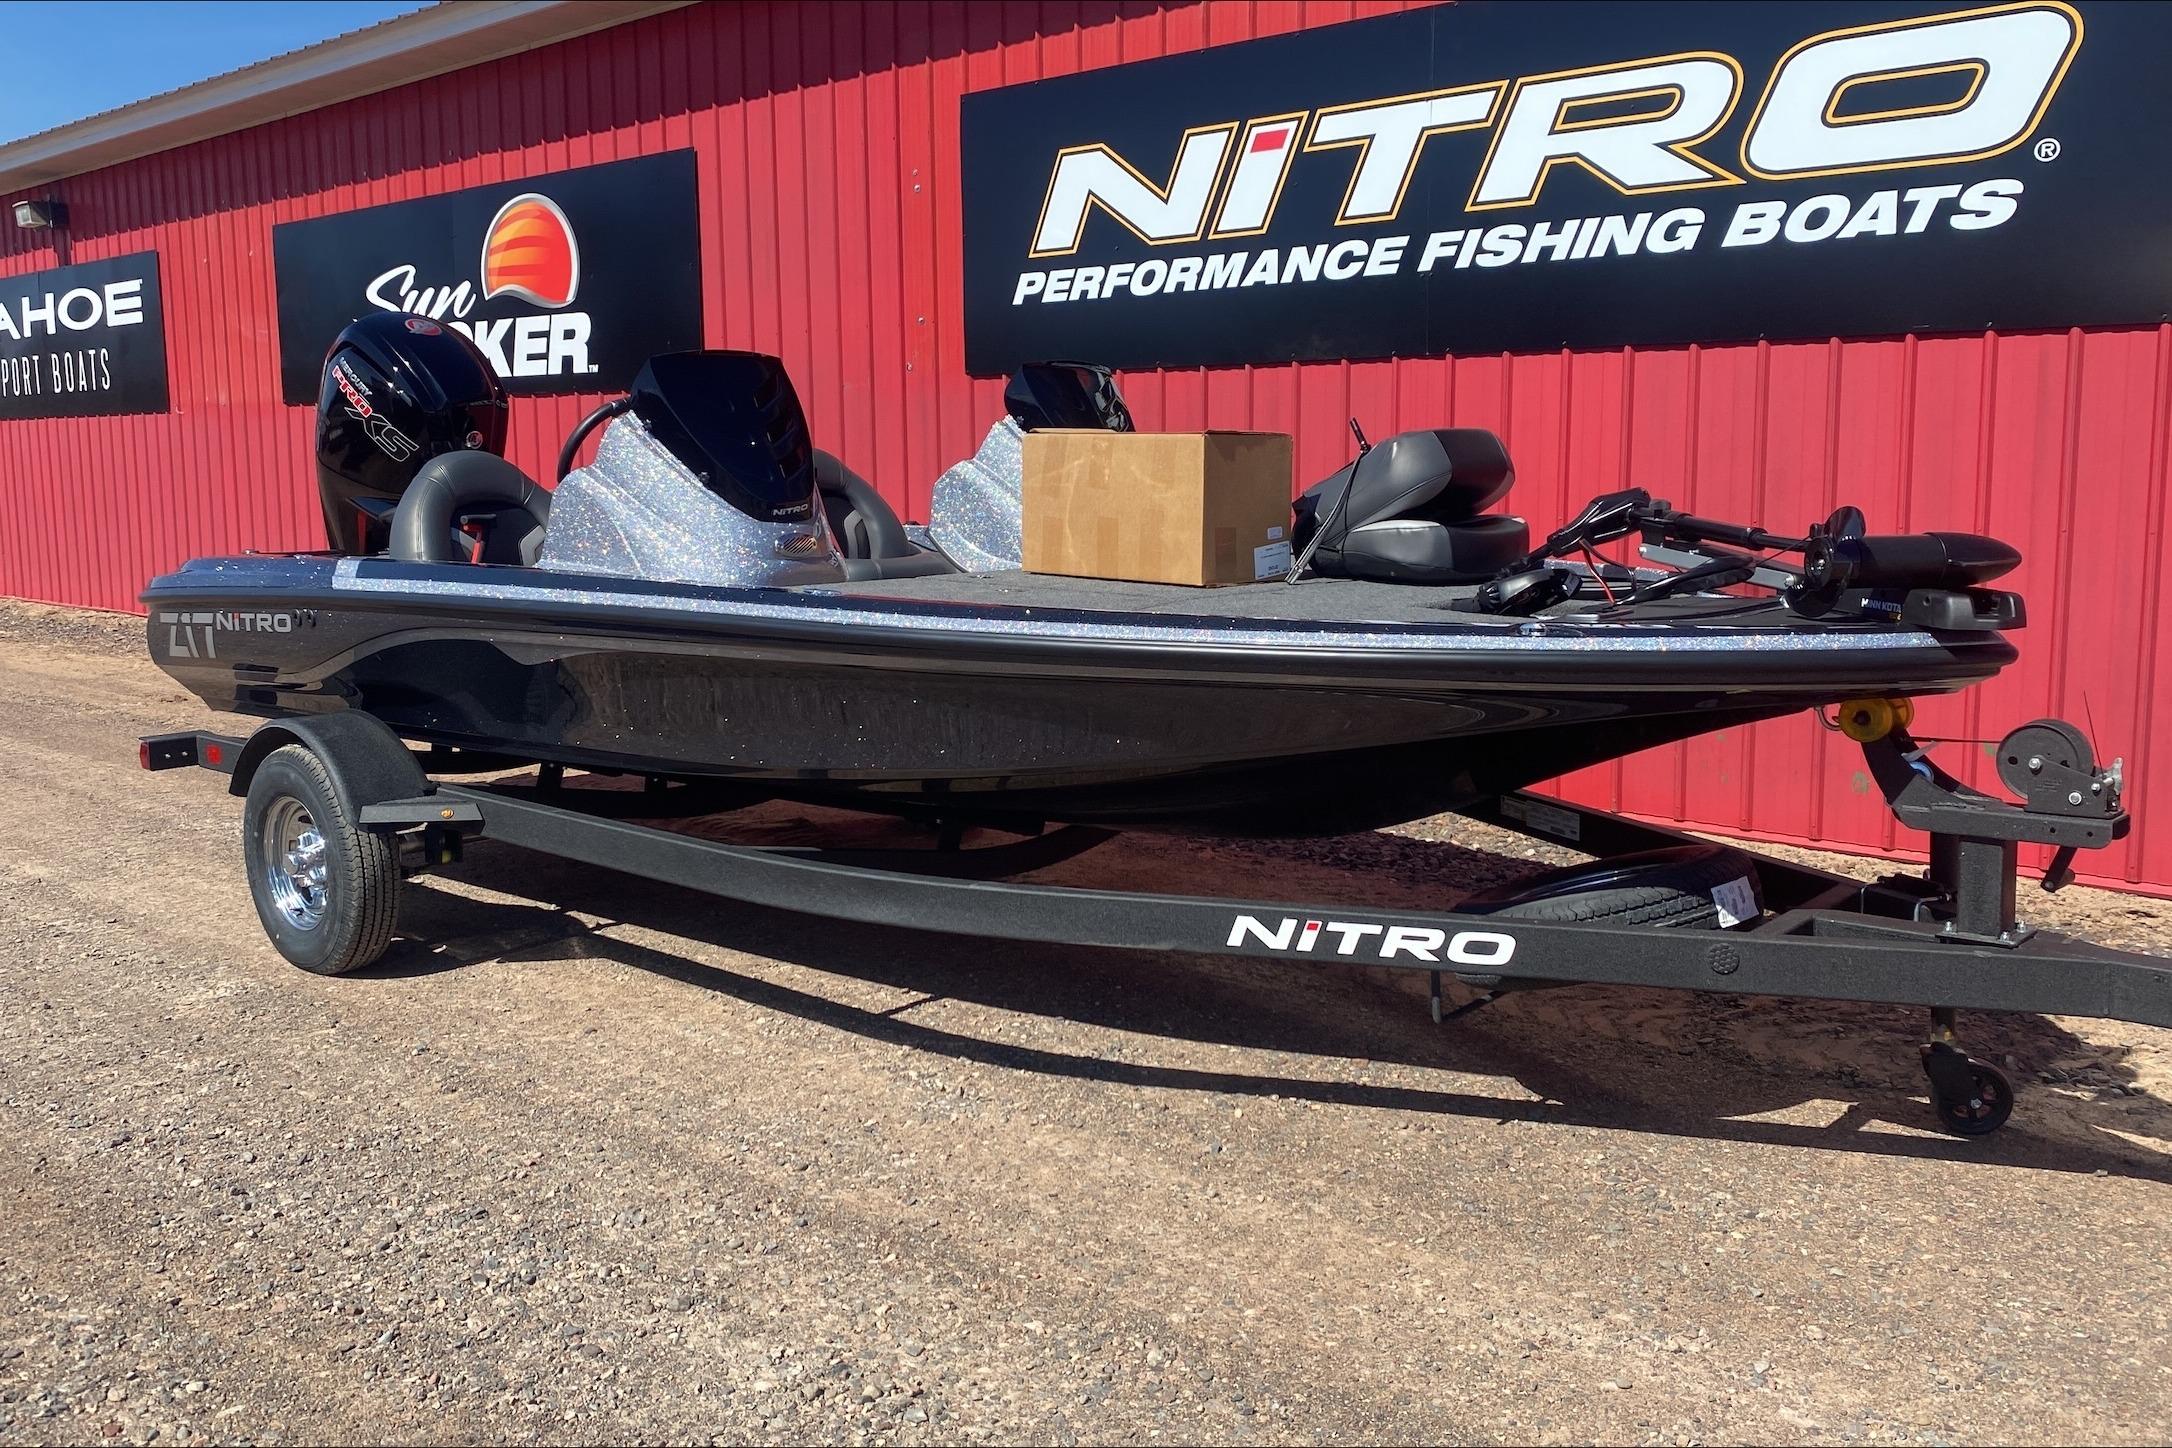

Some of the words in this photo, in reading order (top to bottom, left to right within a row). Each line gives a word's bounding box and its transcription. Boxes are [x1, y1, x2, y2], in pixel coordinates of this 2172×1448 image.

[1012, 236, 1402, 305] PERFORMANCE
[1417, 207, 1706, 274] FISHING
[1721, 178, 2025, 248] BOATS
[366, 264, 477, 320] Sun
[51, 348, 111, 393] BOATS
[332, 365, 373, 418] PRO
[340, 357, 373, 396] MERCURY
[344, 406, 420, 462] XS
